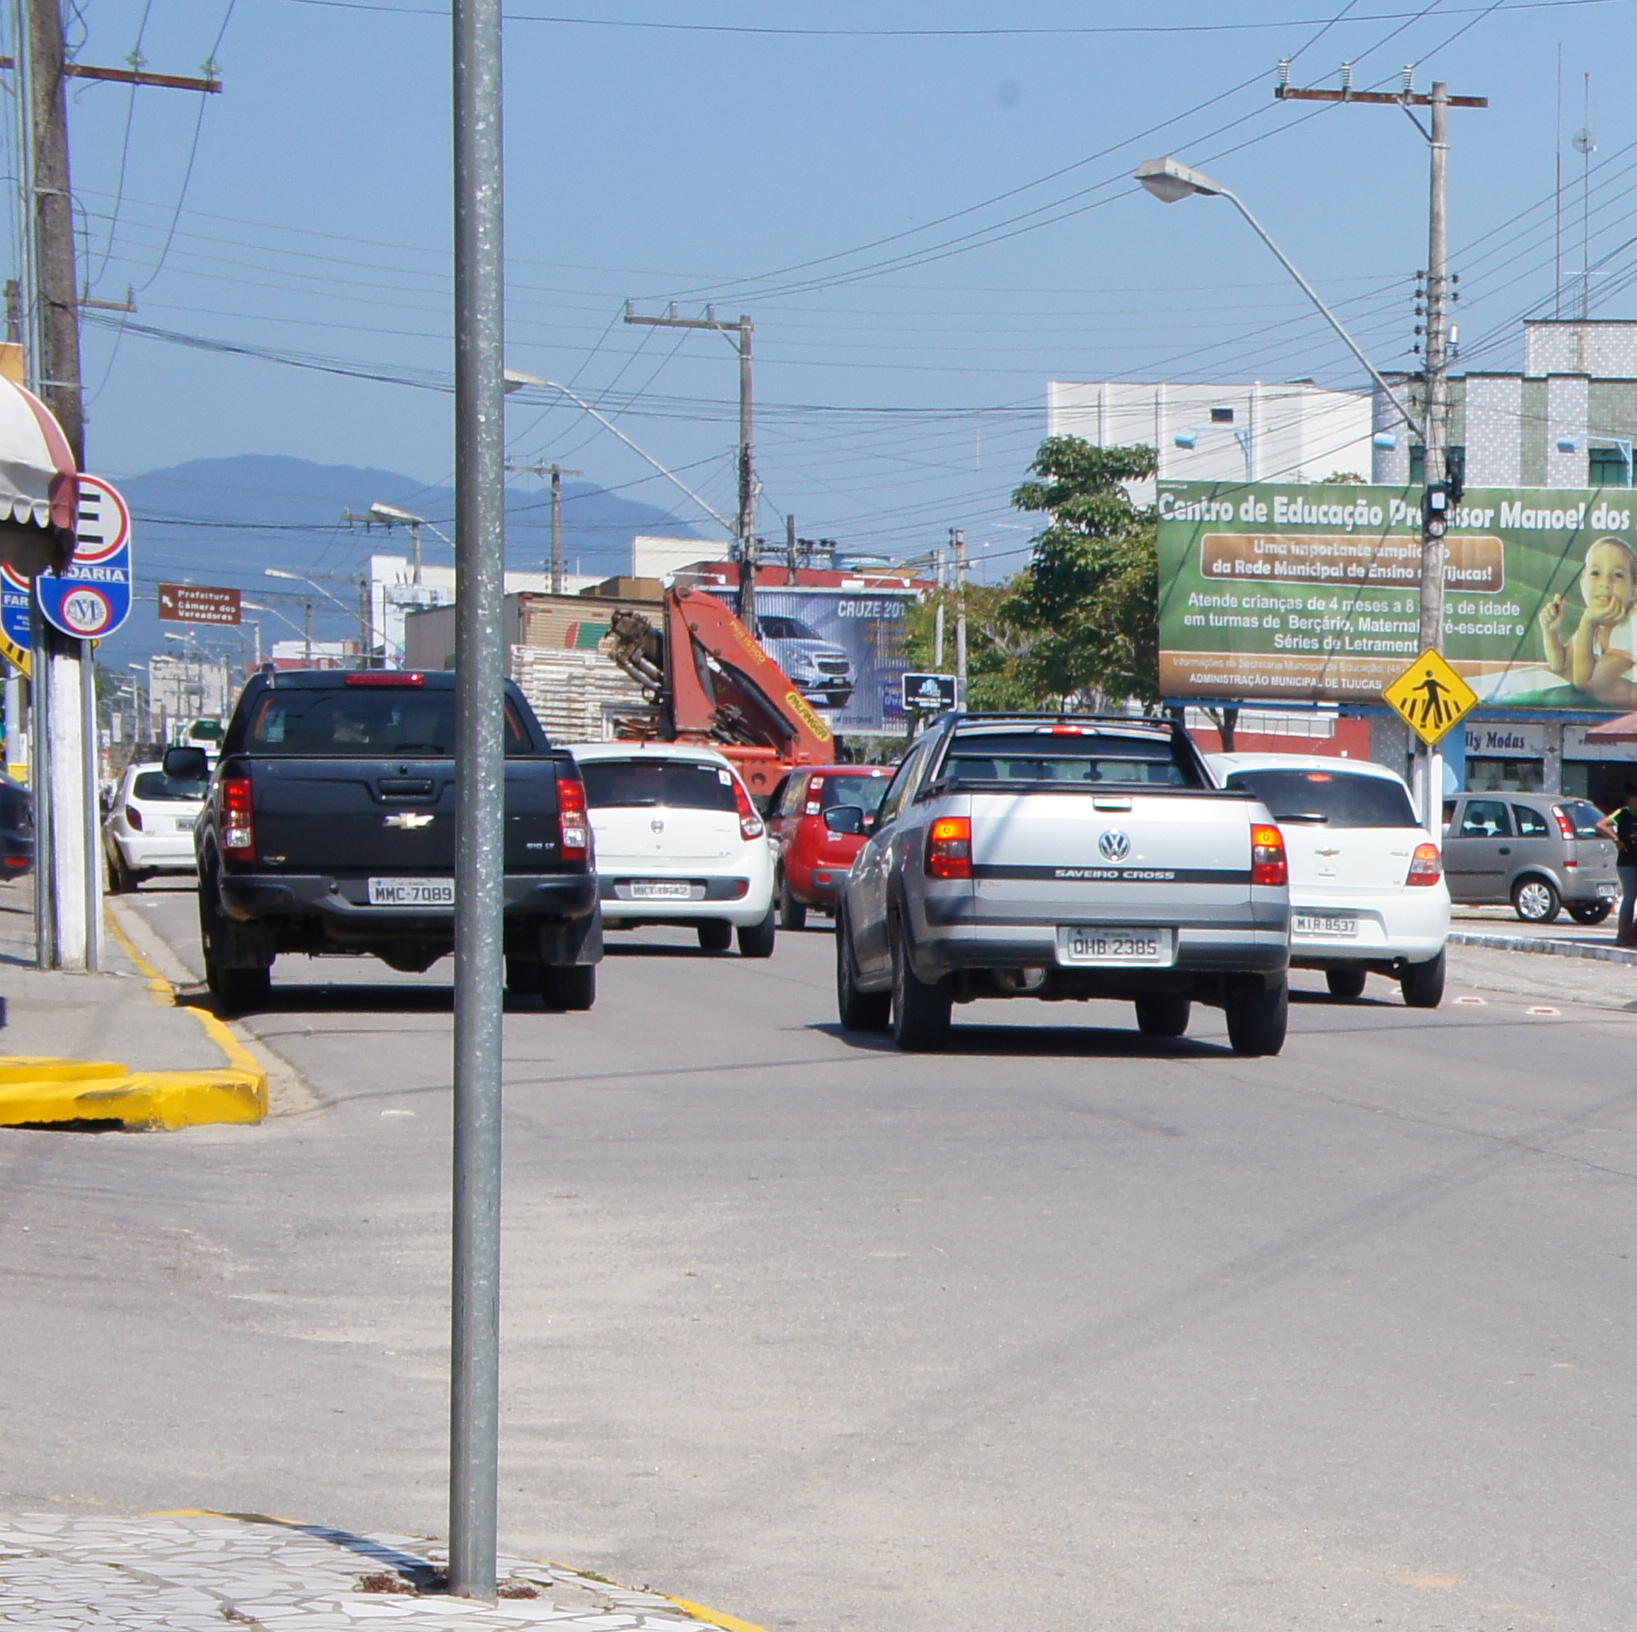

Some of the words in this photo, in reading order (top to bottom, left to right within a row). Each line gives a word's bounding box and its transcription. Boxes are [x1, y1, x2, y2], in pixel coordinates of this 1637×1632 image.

[1158, 492, 1234, 523] Centro
[1239, 495, 1268, 522] de
[1273, 496, 1383, 531] Educação
[1500, 501, 1586, 530] Manoel
[1591, 503, 1630, 531] dos
[1253, 540, 1288, 555] Uma
[1290, 541, 1372, 559] importante
[1212, 560, 1231, 574] da
[1235, 561, 1271, 575] Rede
[1274, 561, 1344, 578] Municipal
[1347, 562, 1365, 578] de
[1368, 563, 1414, 579] Ensino
[178, 590, 230, 601] Prefeitura
[1188, 592, 1238, 608] Atende
[1242, 594, 1303, 613] crianças
[1307, 596, 1326, 611] de
[1329, 597, 1338, 611] 4
[1342, 601, 1388, 612] meses
[1393, 602, 1401, 613] a
[1405, 599, 1415, 613] 8
[178, 600, 215, 612] Câmara
[219, 603, 237, 614] dos
[178, 610, 233, 622] Vereadores
[838, 601, 881, 618] CRUZE
[1458, 600, 1476, 615] de
[1480, 601, 1520, 616] idade
[1184, 615, 1205, 627] em
[1209, 613, 1258, 628] turmas
[1263, 614, 1281, 629] de
[1288, 615, 1354, 633] Berçário,
[1358, 617, 1420, 634] Maternal
[1516, 625, 1525, 637] e
[1274, 633, 1319, 650] Séries
[1323, 635, 1341, 650] de
[1345, 636, 1419, 653] Letrament
[1173, 657, 1224, 669] Informações
[1239, 658, 1282, 670] Secretaria
[1285, 659, 1327, 672] Municipal
[1190, 672, 1269, 688] ADMINISTRAÇÃO
[1270, 675, 1322, 687] MUNICIPAL
[1325, 677, 1338, 688] DE
[1341, 678, 1382, 690] TIJUCAS
[786, 693, 829, 740] PALFINGER
[1486, 731, 1525, 749] Modas
[1055, 869, 1119, 879] SAVEIRO
[1123, 870, 1175, 880] CROSS
